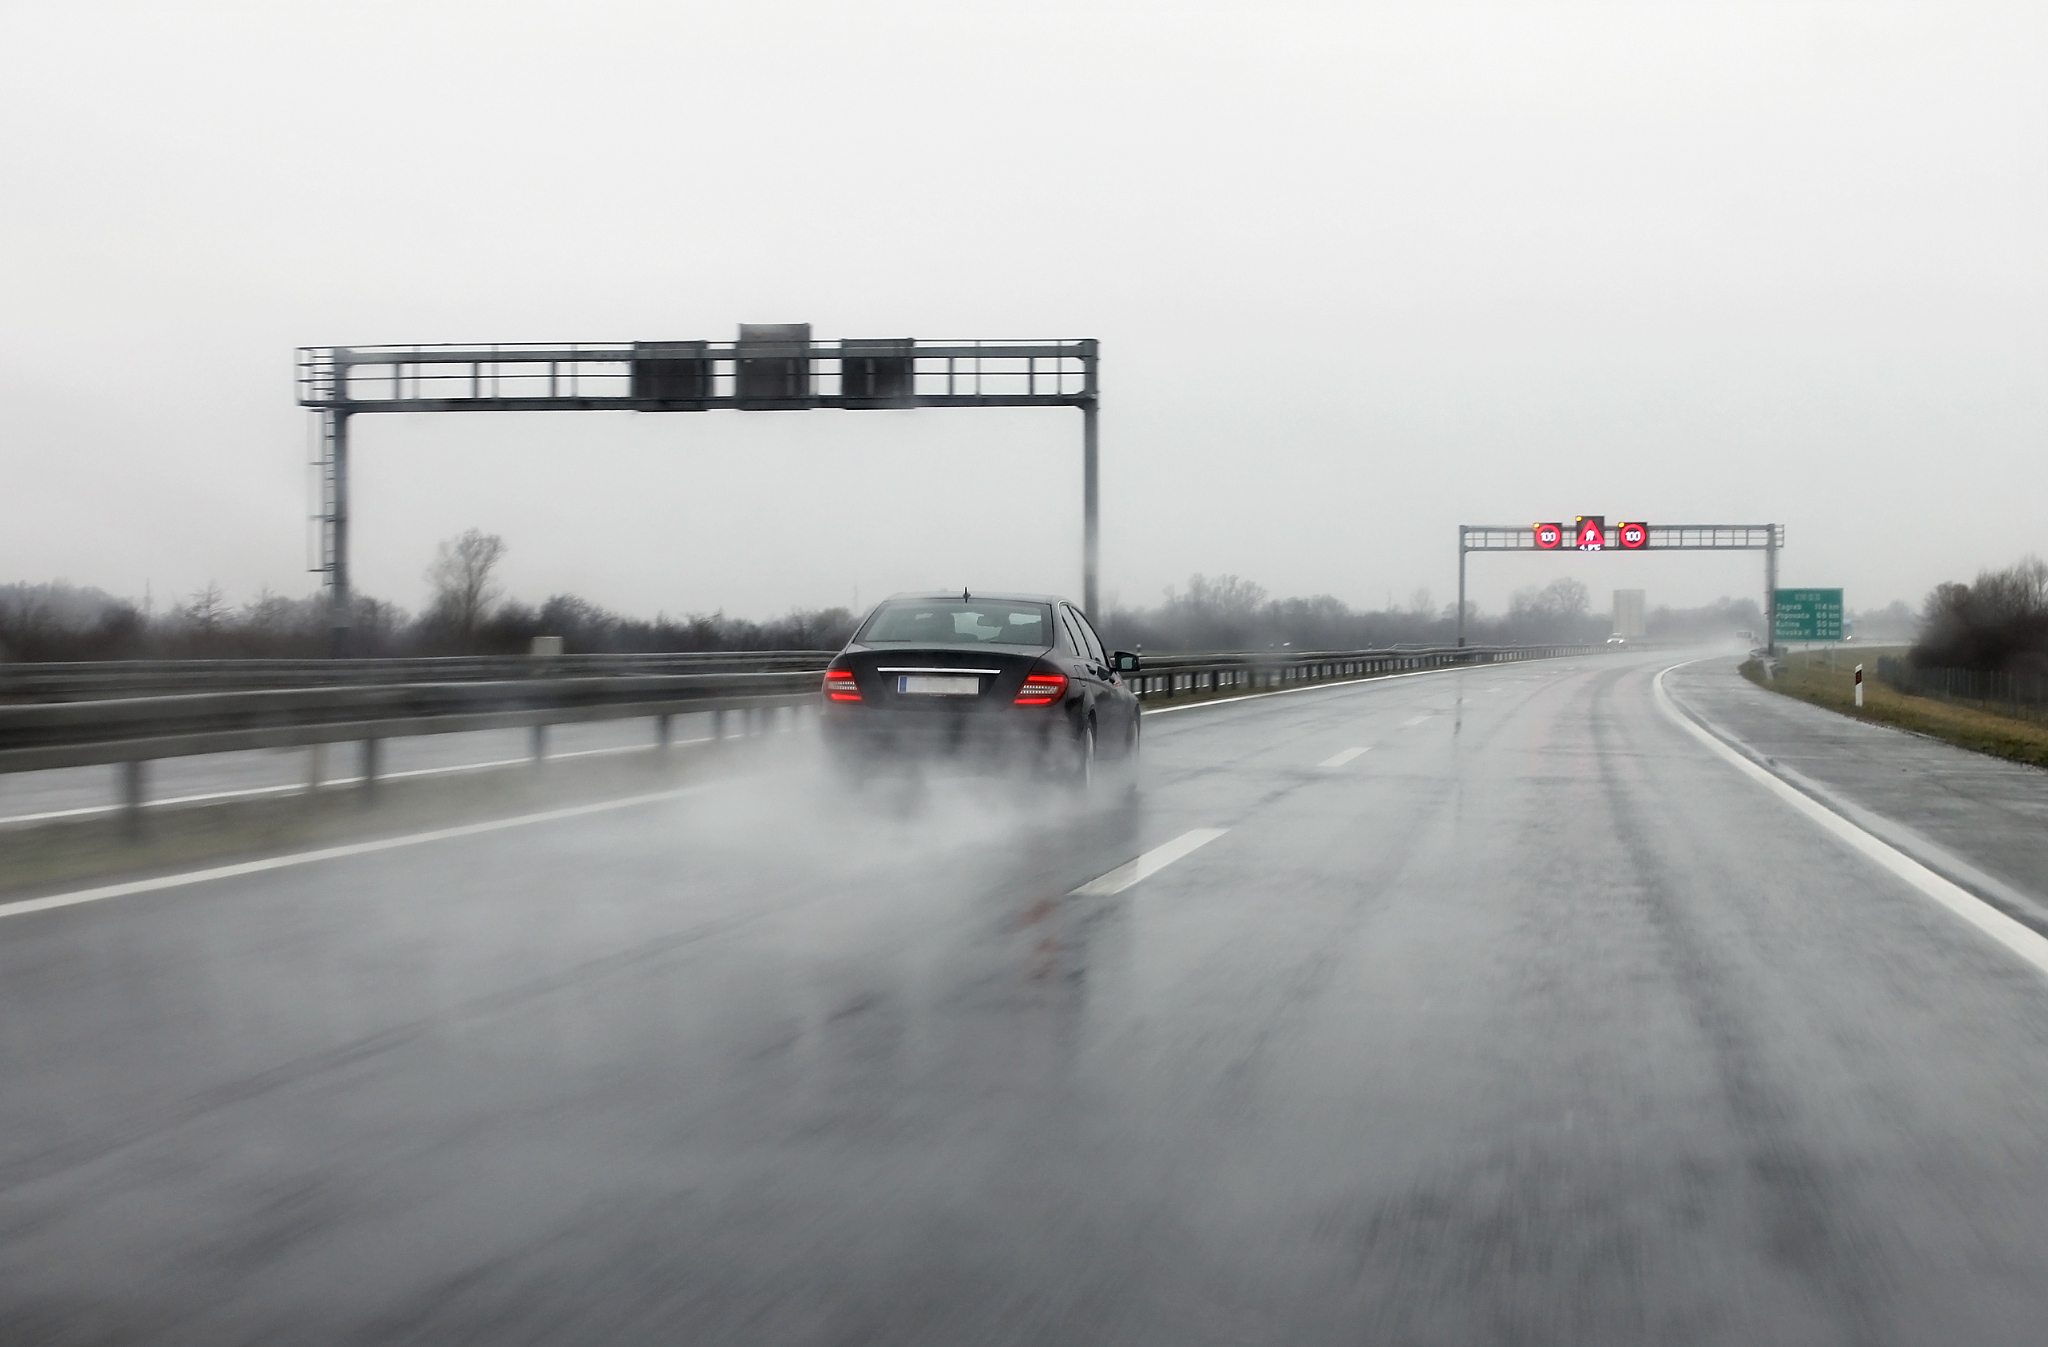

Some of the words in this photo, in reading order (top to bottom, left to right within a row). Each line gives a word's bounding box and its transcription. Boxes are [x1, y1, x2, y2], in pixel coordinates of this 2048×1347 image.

[1540, 532, 1556, 541] 100
[1625, 531, 1641, 541] 100
[1776, 603, 1802, 611] Zagreb
